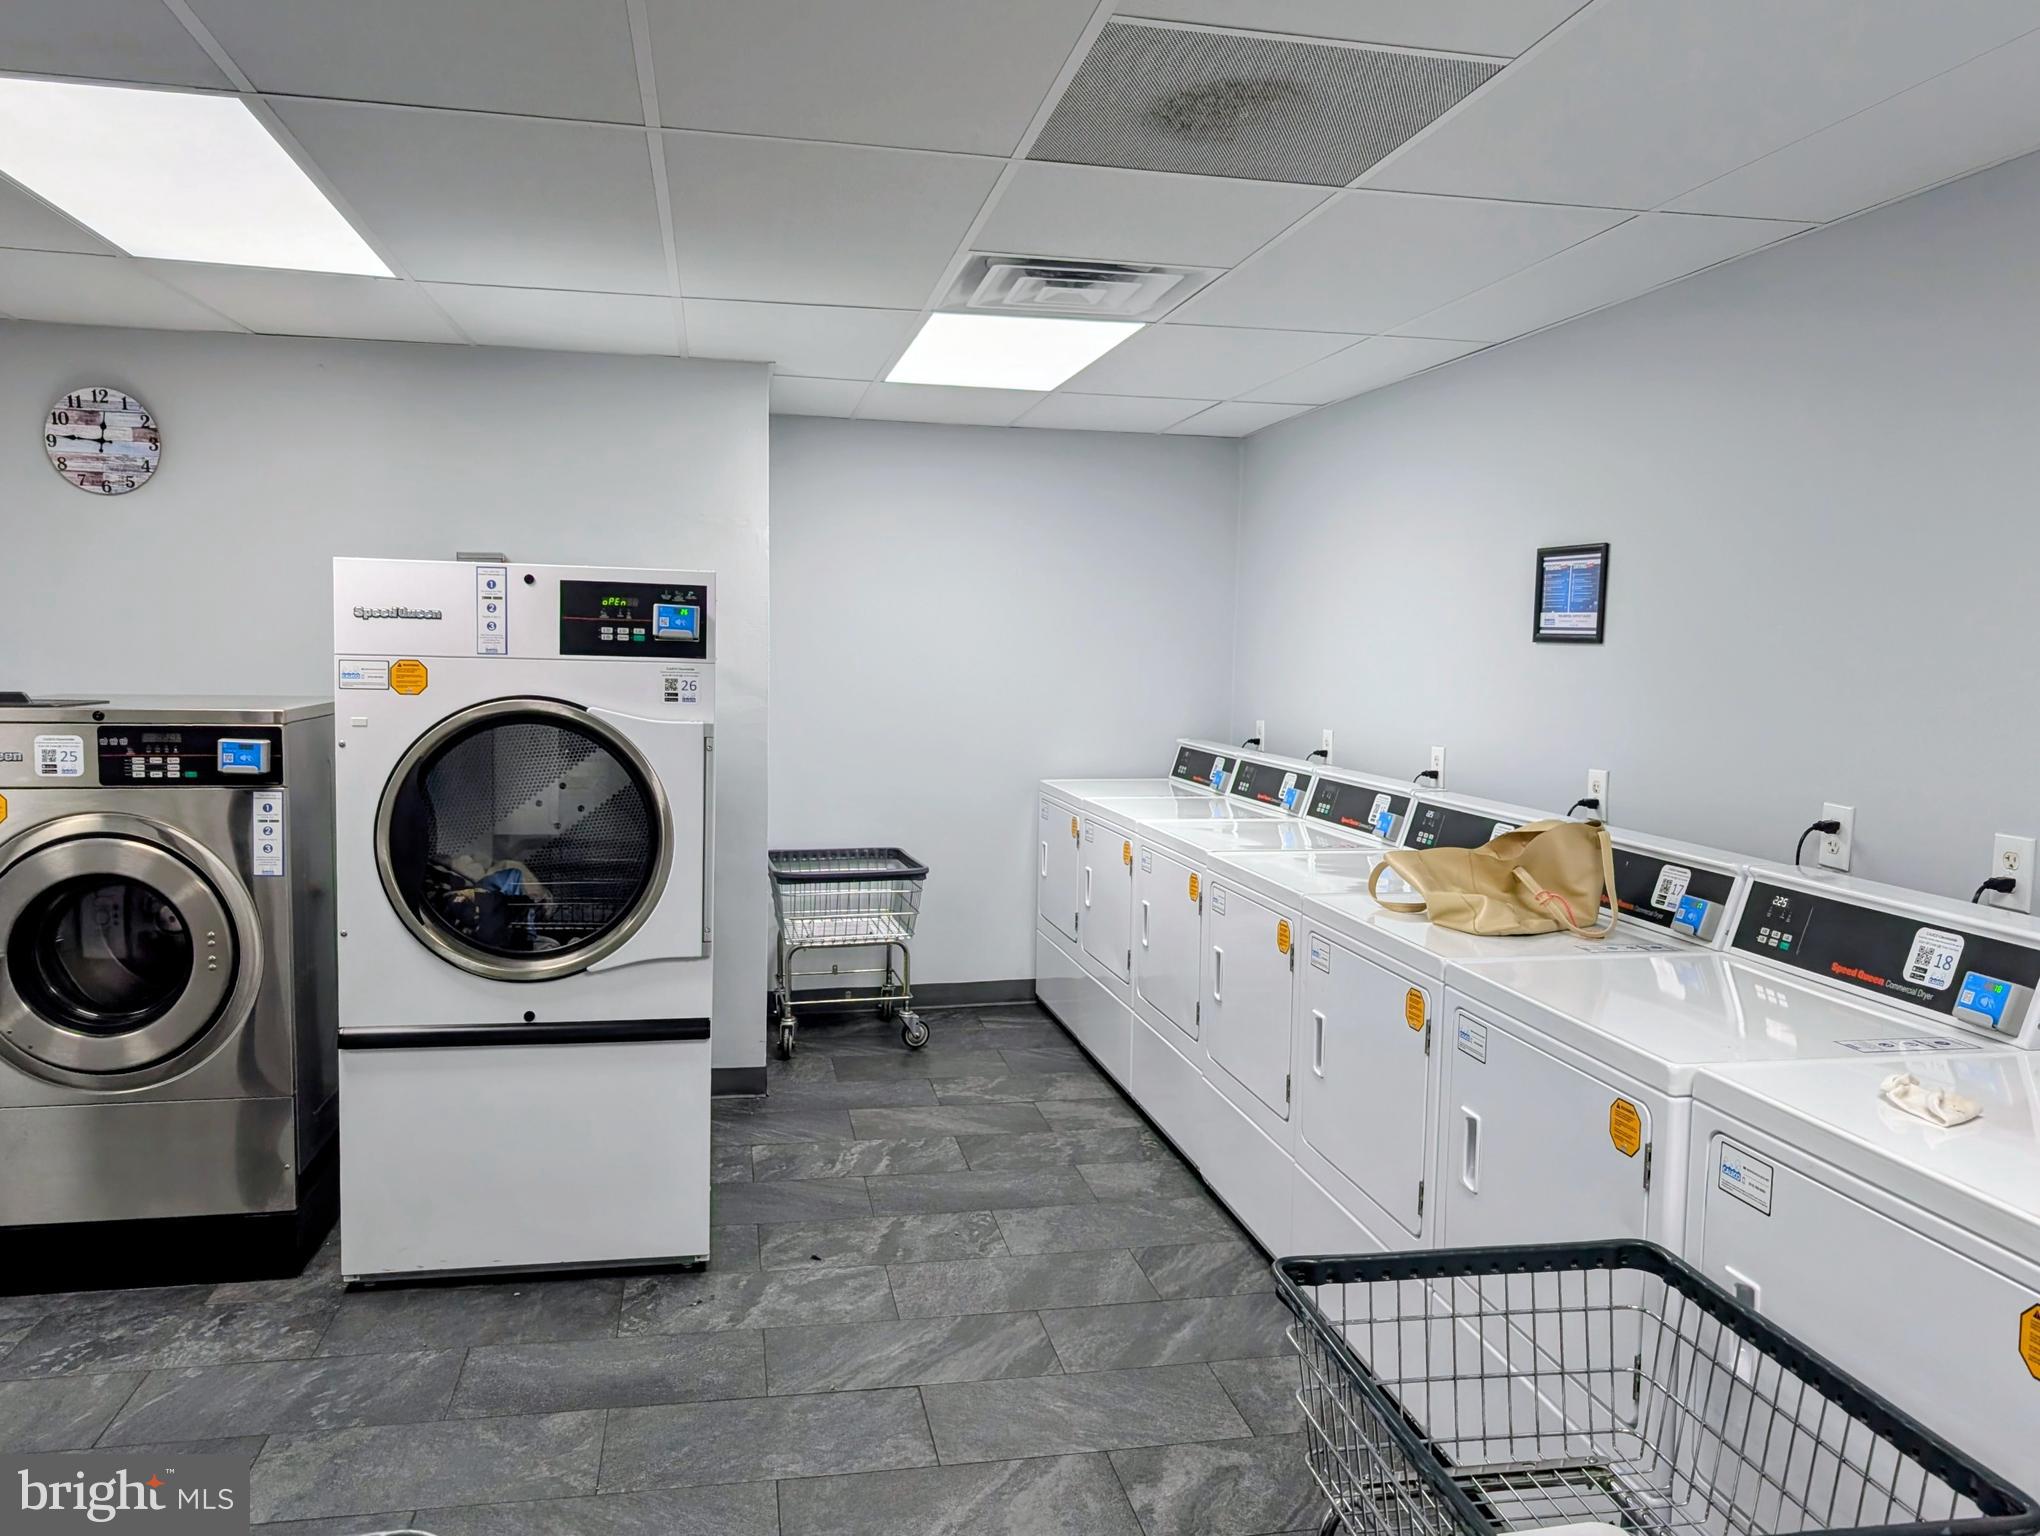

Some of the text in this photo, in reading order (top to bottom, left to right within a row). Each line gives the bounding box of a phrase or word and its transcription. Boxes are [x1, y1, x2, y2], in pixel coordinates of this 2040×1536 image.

[67, 395, 82, 408] 11
[91, 389, 109, 404] 12
[121, 397, 129, 410] 1
[51, 411, 69, 425] 10
[140, 415, 150, 429] 2
[46, 434, 57, 447] 9
[149, 438, 159, 451] 3
[57, 457, 68, 471] 8
[141, 459, 151, 472] 4
[77, 474, 86, 486] 7
[102, 480, 112, 493] 6
[126, 476, 135, 488] 5
[353, 606, 442, 620] Speed Queen
[681, 679, 697, 691] 26
[60, 750, 78, 762] 25
[1671, 883, 1684, 896] 17
[1933, 953, 1954, 971] 18
[1831, 961, 1858, 977] Speed
[1857, 969, 1885, 986] Queen
[1885, 979, 1918, 996] Commercial
[1917, 989, 1935, 1001] Dryer
